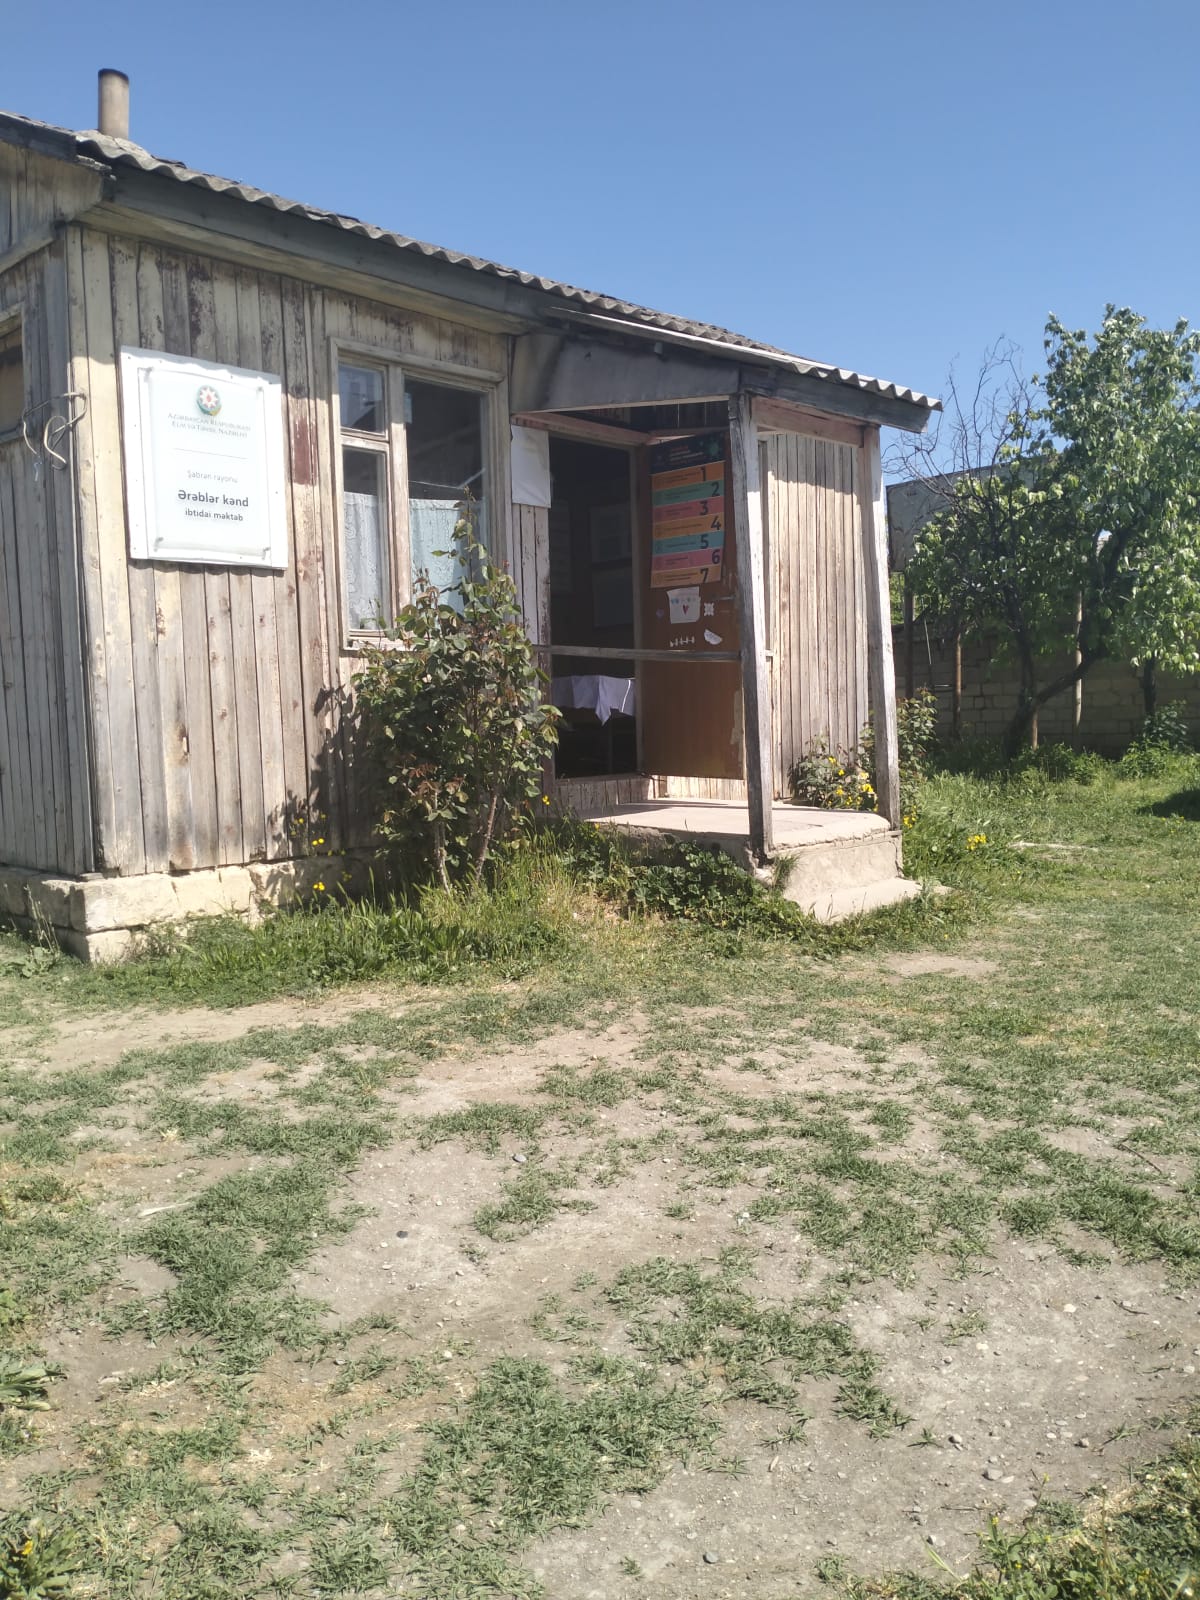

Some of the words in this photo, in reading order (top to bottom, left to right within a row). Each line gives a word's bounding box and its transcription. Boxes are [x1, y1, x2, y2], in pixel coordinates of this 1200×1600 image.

[700, 465, 706, 482] 1
[178, 489, 219, 503] Ərəblər
[222, 493, 249, 507] kənd
[711, 481, 720, 498] 2
[699, 500, 708, 516] 3
[711, 515, 721, 531] 4
[700, 534, 709, 549] 5
[711, 548, 720, 565] 6
[700, 567, 709, 584] 7
